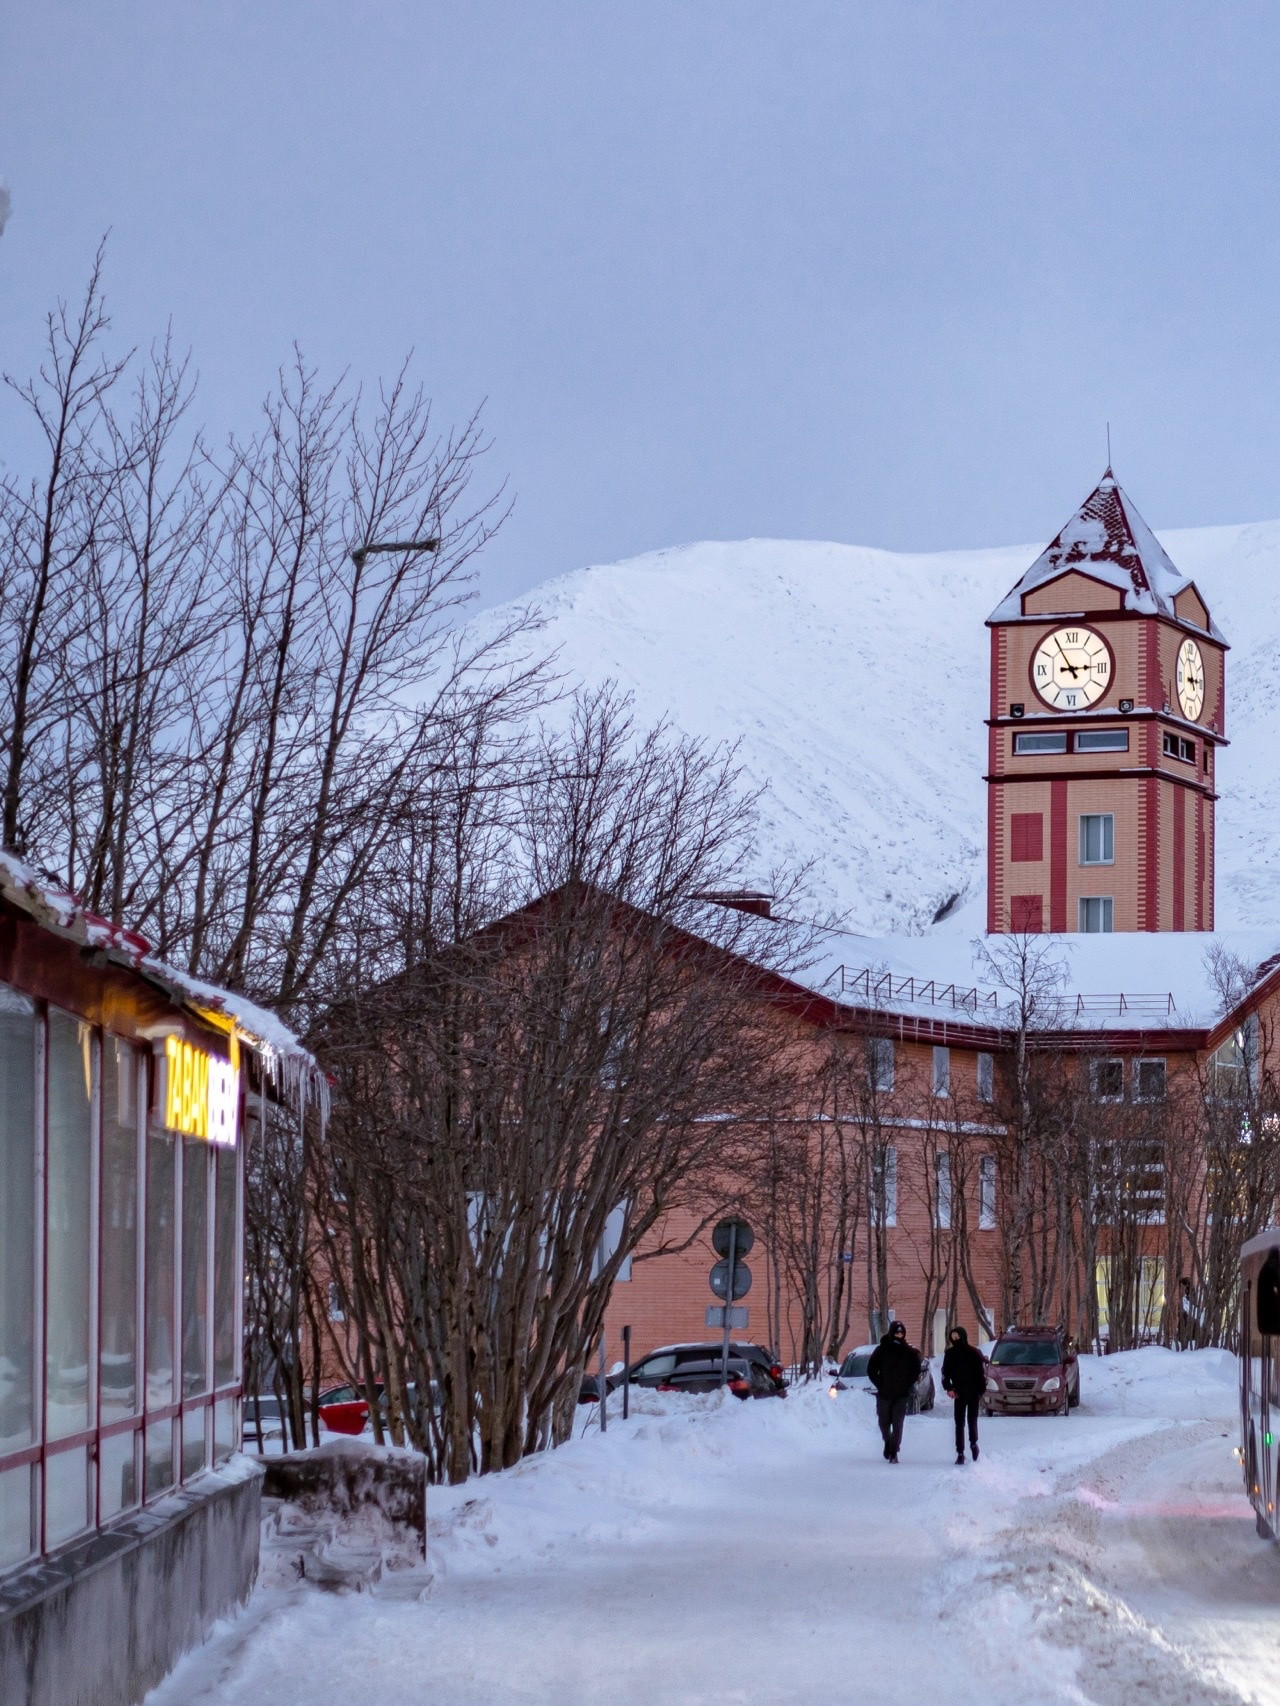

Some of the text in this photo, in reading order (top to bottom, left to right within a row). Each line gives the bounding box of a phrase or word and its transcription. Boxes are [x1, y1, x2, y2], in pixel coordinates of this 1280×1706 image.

[1065, 631, 1079, 644] XII
[1037, 664, 1047, 676] IX
[1097, 662, 1107, 674] III
[1066, 694, 1077, 707] VI
